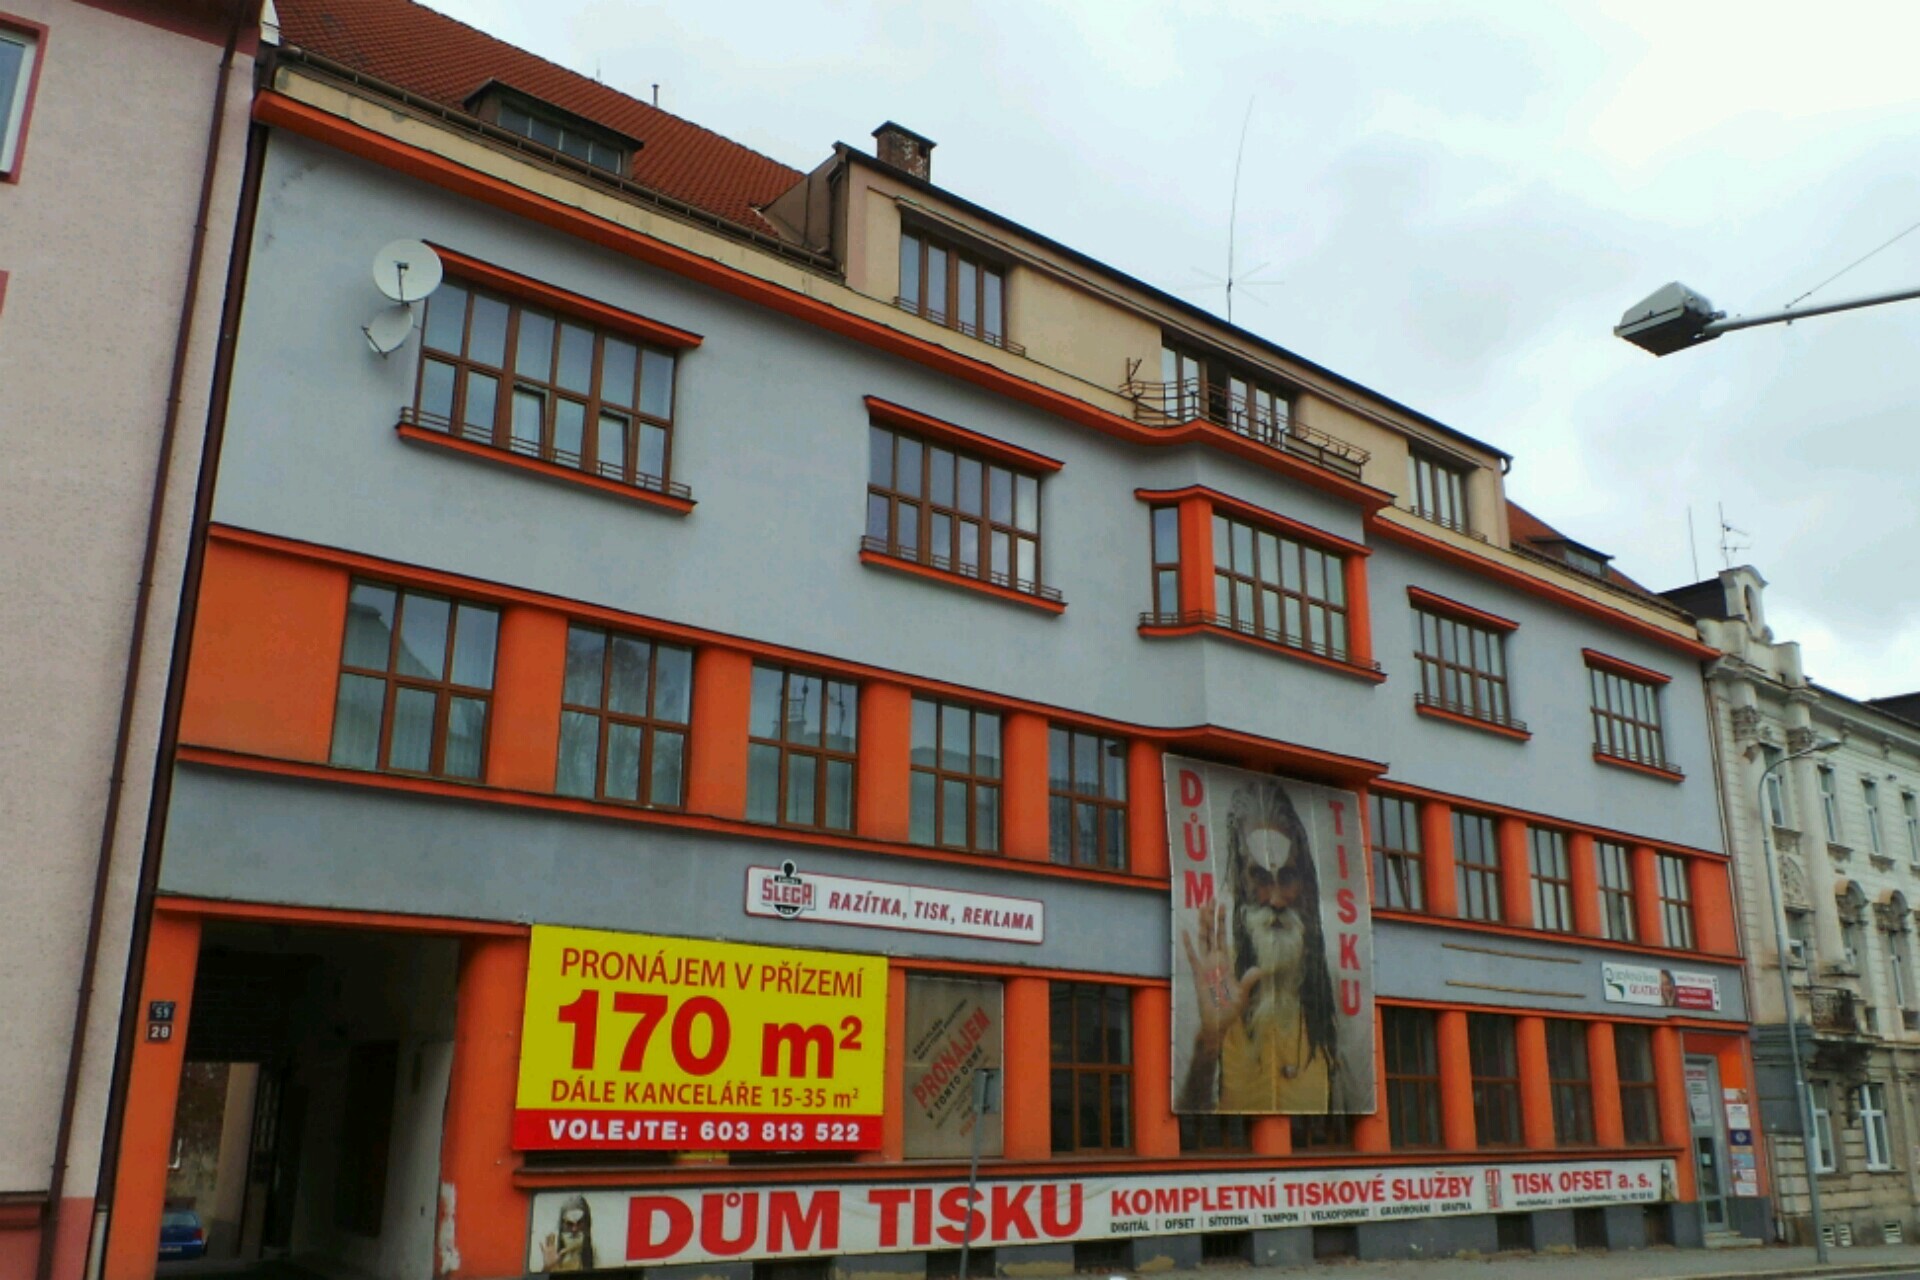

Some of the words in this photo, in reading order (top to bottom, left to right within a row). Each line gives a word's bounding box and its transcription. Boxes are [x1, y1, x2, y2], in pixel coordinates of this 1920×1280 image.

[1179, 770, 1214, 909] DŮM
[828, 889, 908, 920] RAZÍTKA,
[914, 900, 956, 925] TISK,
[962, 907, 1034, 931] REKLAMA
[1328, 800, 1361, 1017] TISKU
[561, 947, 726, 988] PRONÁJEM
[734, 963, 755, 990] V
[760, 960, 865, 999] PŘÍZEMÍ
[150, 1025, 169, 1038] 28
[556, 988, 732, 1077] 170
[912, 1006, 991, 1109] PRONÁJEM
[551, 1075, 616, 1103] DÁLE
[624, 1080, 762, 1107] KANCELÁŘE
[771, 1087, 827, 1108] 15-35
[549, 1118, 688, 1141] VOLEJTE:
[699, 1121, 750, 1142] 603
[761, 1122, 804, 1142] 813
[815, 1123, 860, 1142] 522
[1110, 1177, 1277, 1217] KOMPLETNÍ
[1283, 1174, 1386, 1208] TISKOVÉ
[1391, 1170, 1475, 1201] SLUŽBY
[1511, 1172, 1555, 1195] TISK
[1558, 1168, 1614, 1193] OFSET
[1618, 1173, 1634, 1189] a.
[1637, 1172, 1653, 1188] s.
[625, 1189, 841, 1261] DŮM
[868, 1182, 1084, 1248] TISKU
[1110, 1219, 1150, 1233] DIGITÁL
[1165, 1218, 1196, 1230] OFSET
[1208, 1214, 1250, 1228] SÍTOTISK
[1262, 1212, 1299, 1224] TAMPON
